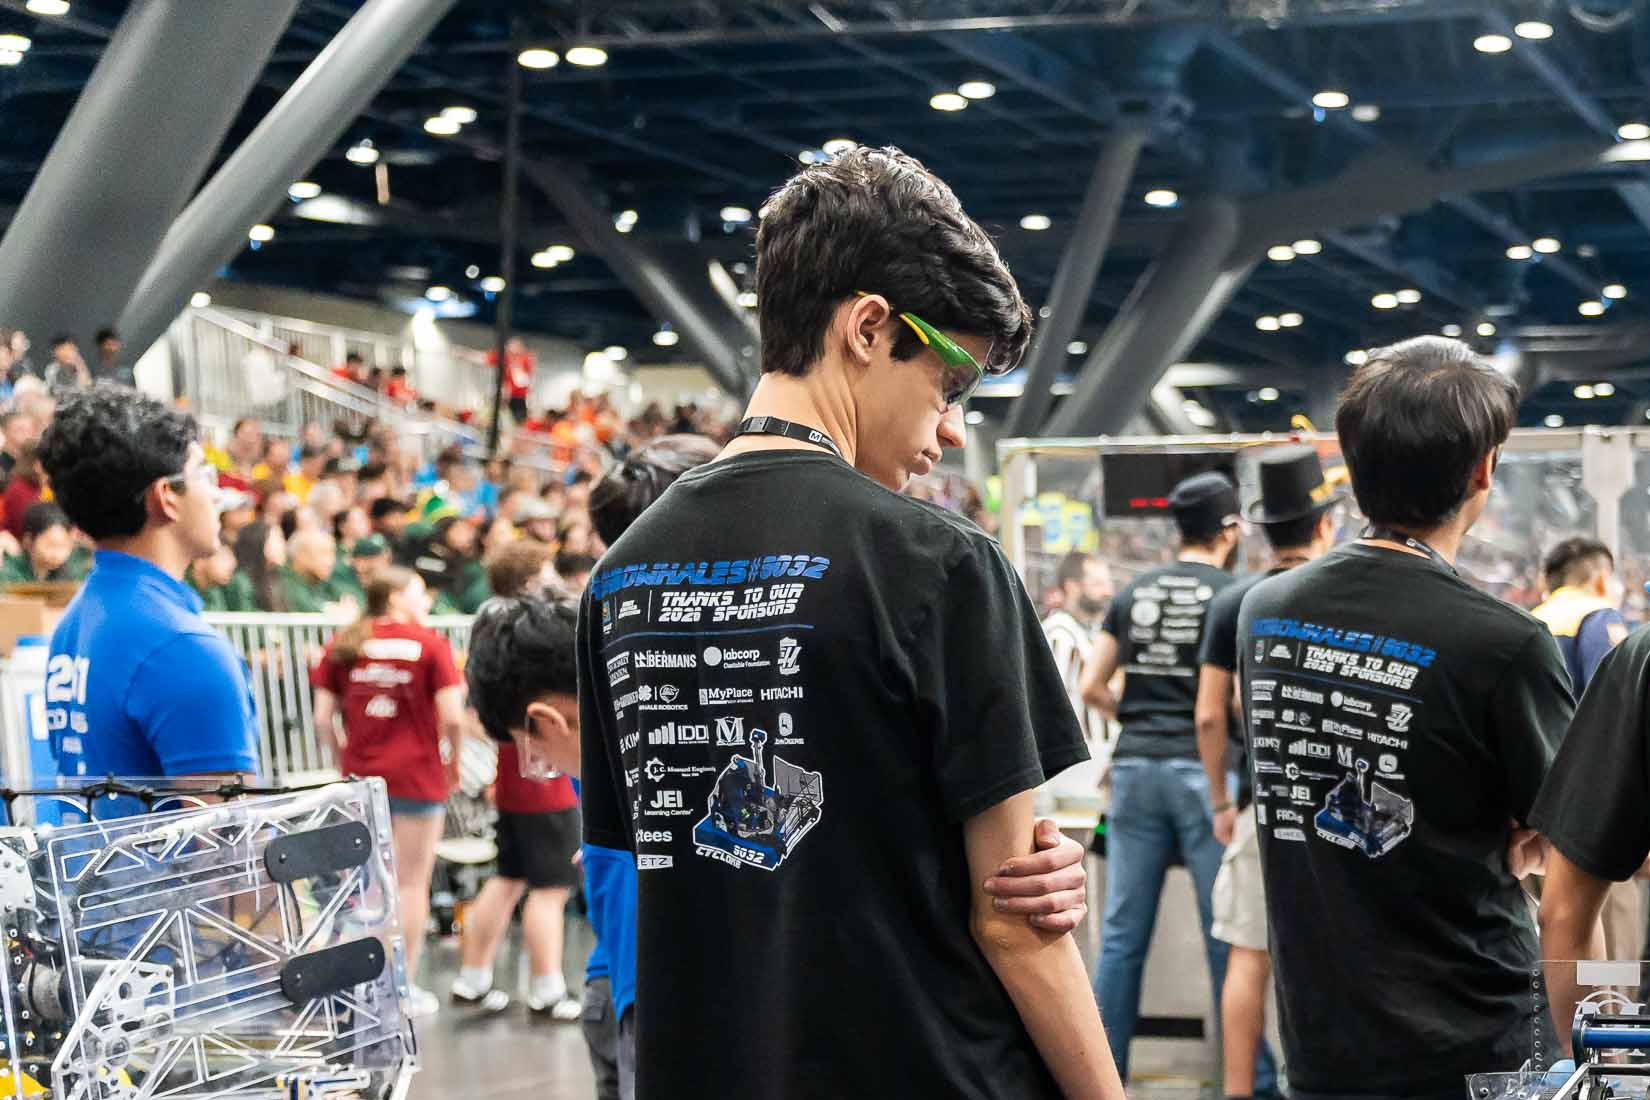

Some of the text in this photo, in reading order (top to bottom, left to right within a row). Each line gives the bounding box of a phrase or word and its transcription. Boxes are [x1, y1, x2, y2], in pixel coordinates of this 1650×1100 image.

[661, 583, 804, 607] THANKS TO OUR
[712, 599, 798, 622] SPONSORS
[724, 649, 760, 661] labcorp
[1305, 646, 1419, 679] THANKS TO OUR
[1339, 664, 1414, 690] SPONSORS
[709, 688, 753, 699] MyPlace
[760, 687, 803, 700] HITACHI
[1367, 732, 1408, 749] HITACHI
[650, 791, 683, 808] JEI
[1290, 786, 1310, 800] JEI
[636, 829, 672, 842] tees
